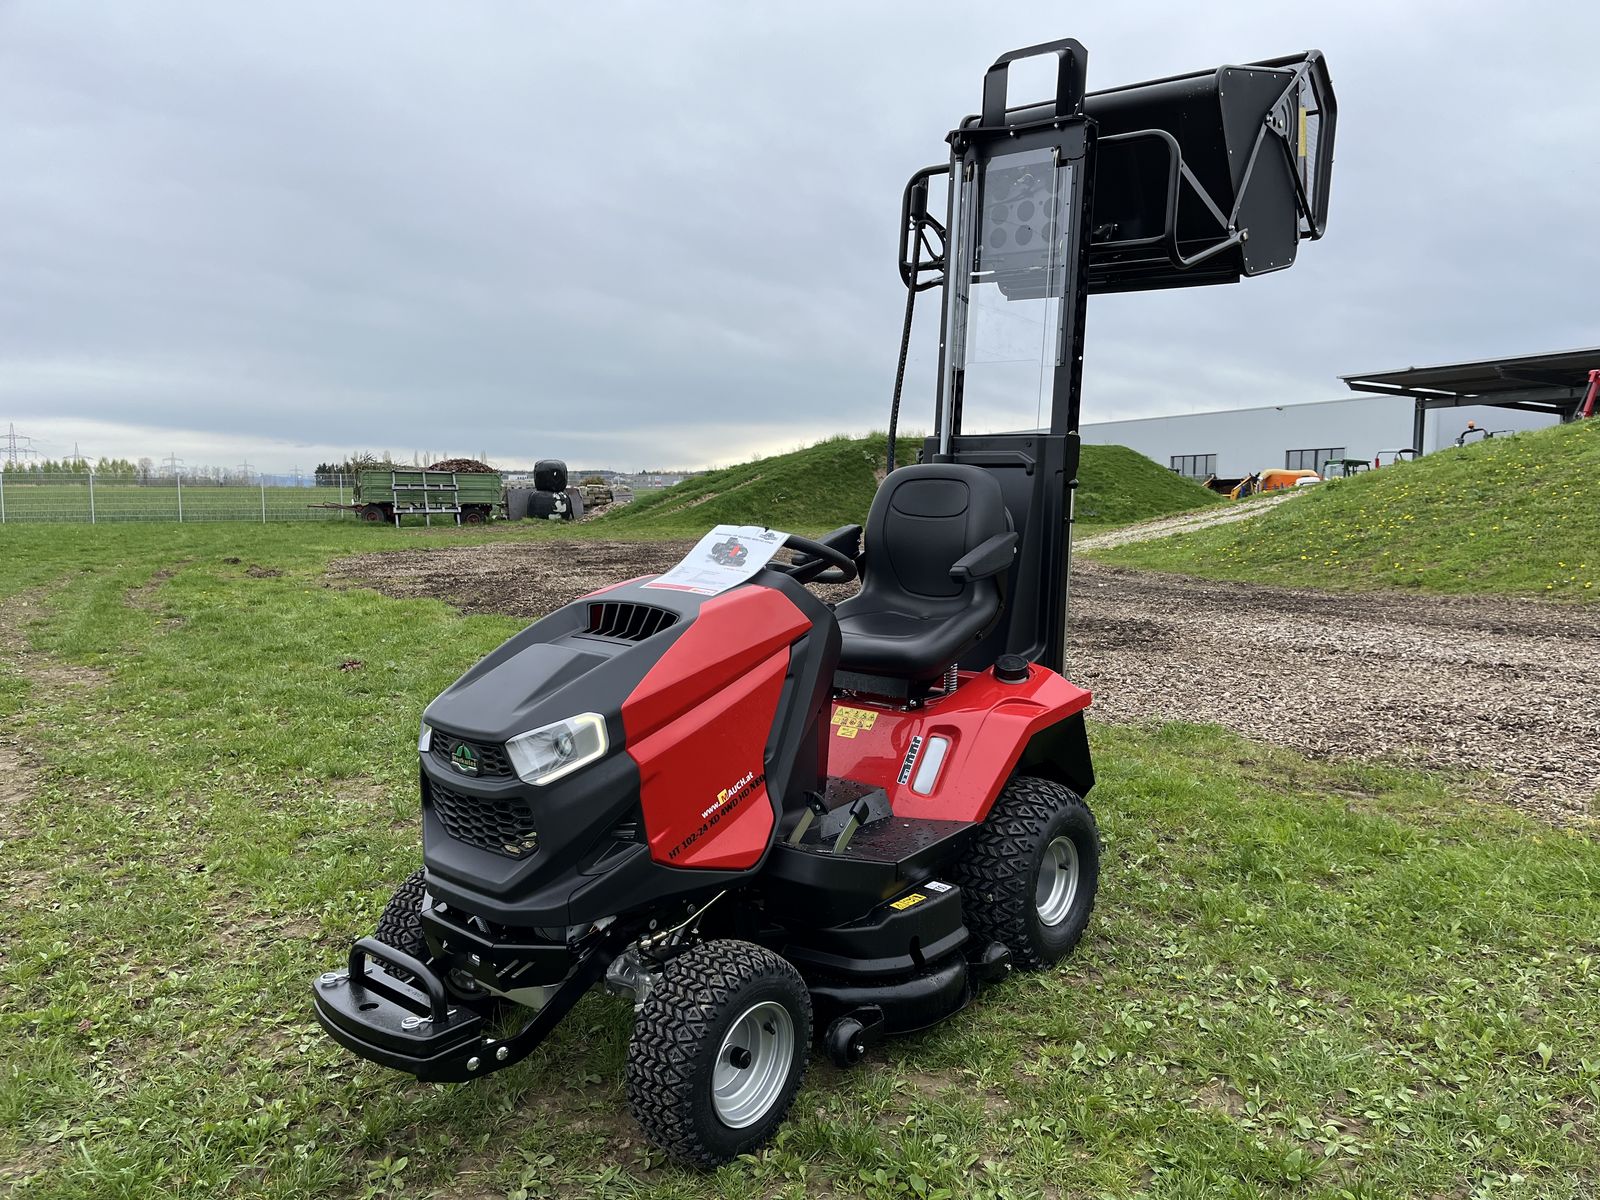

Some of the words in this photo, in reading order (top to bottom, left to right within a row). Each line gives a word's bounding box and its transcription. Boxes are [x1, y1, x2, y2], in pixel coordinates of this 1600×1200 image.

[668, 847, 681, 860] HT
[681, 823, 708, 850] 102-24
[709, 814, 720, 828] XD
[720, 798, 738, 816] 4WD
[738, 788, 750, 802] HD
[701, 771, 753, 819] www.MAUCH.at
